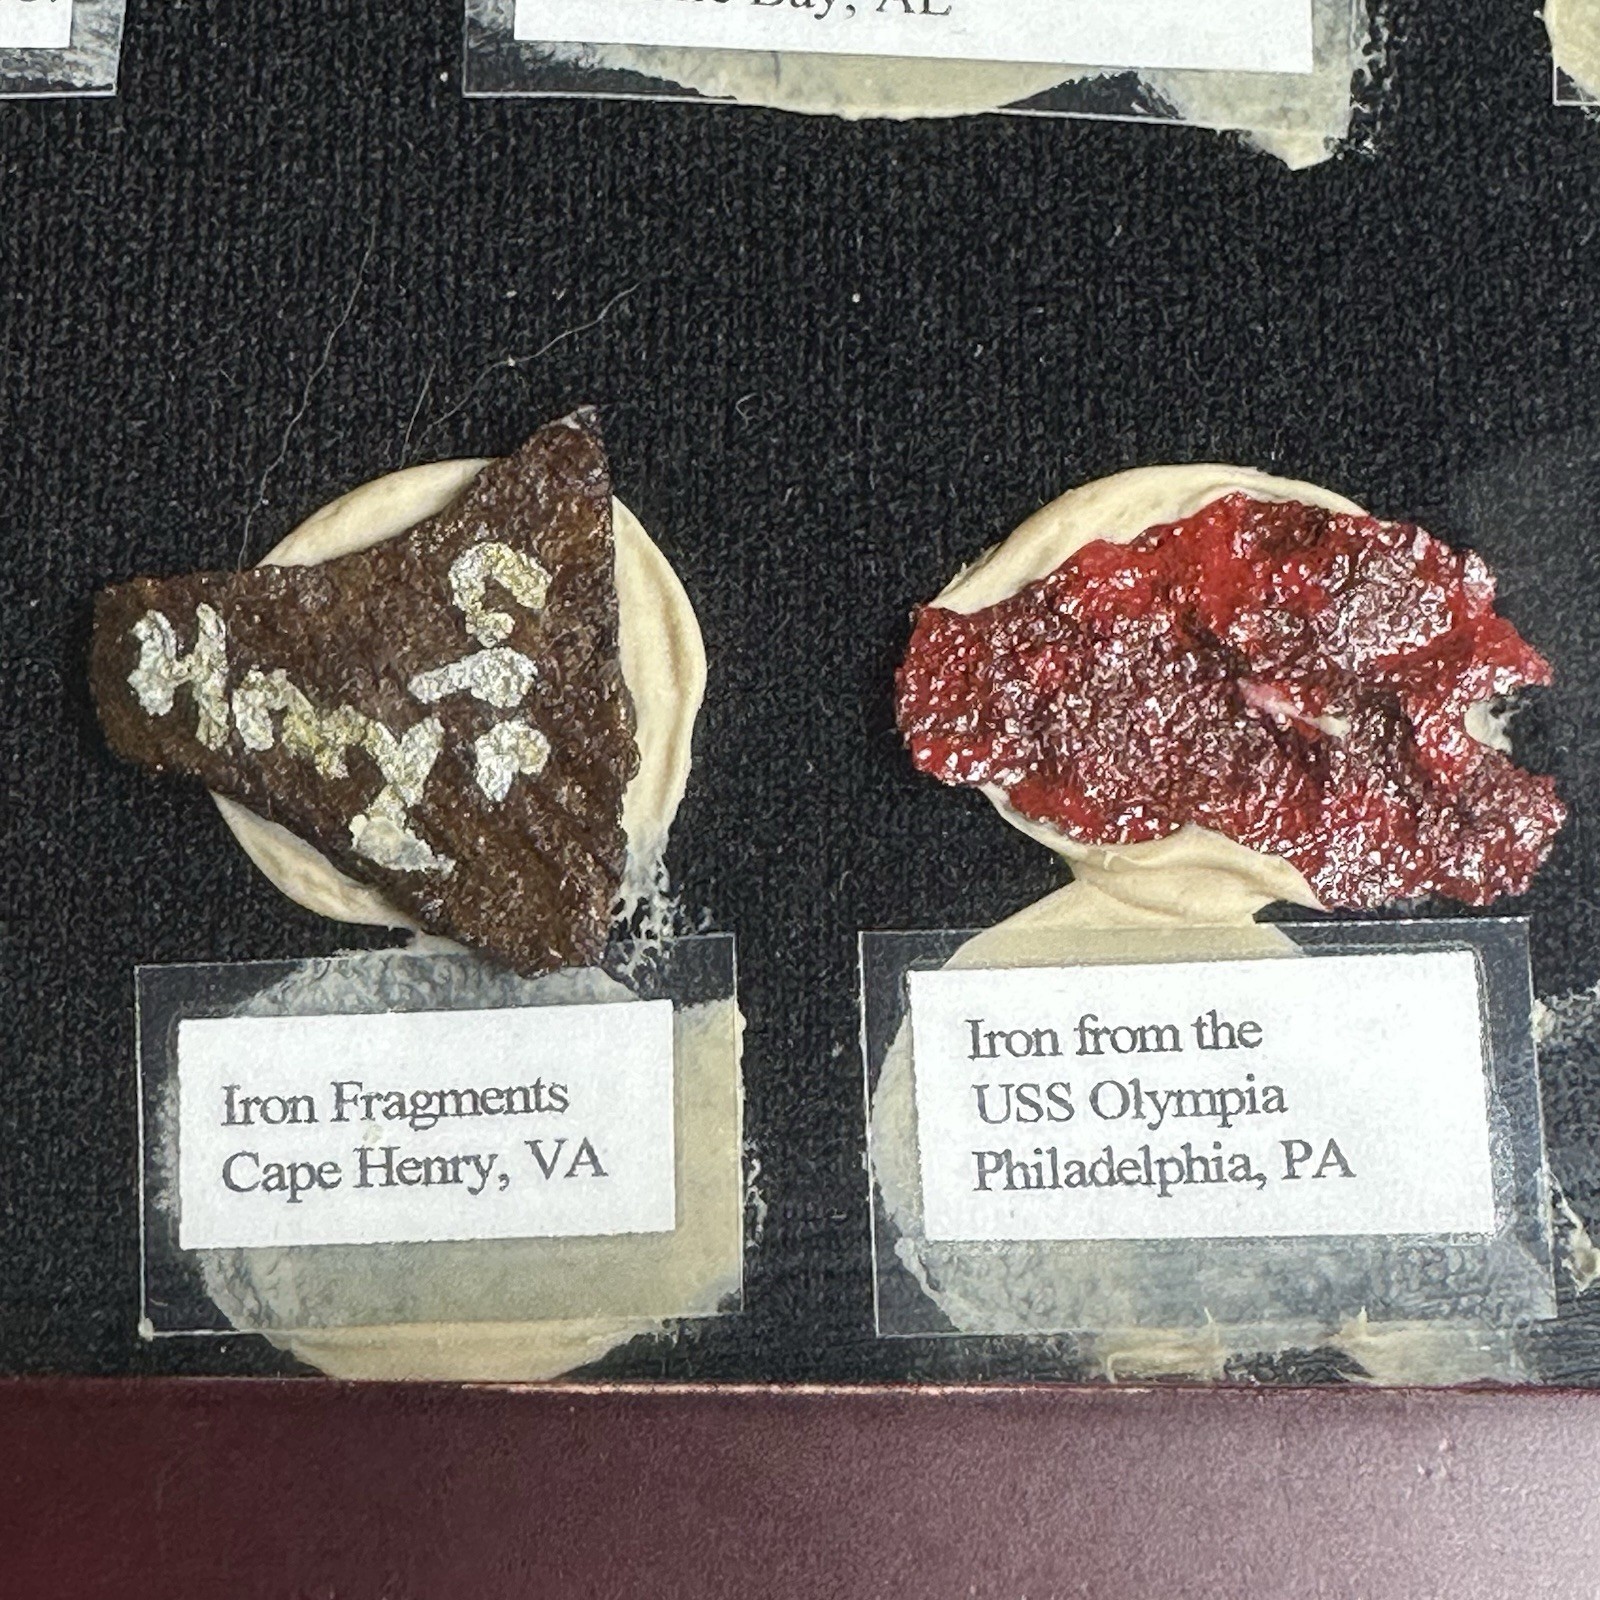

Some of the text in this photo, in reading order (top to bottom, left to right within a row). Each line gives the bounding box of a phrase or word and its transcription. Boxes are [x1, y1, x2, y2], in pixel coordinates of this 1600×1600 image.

[966, 1009, 1263, 1061] Iron from the
[221, 1077, 570, 1131] Iron Fragments
[971, 1074, 1288, 1130] USS Olympia
[222, 1137, 608, 1204] Cape Henry, VA
[972, 1138, 1356, 1197] Philadelphia, PA
